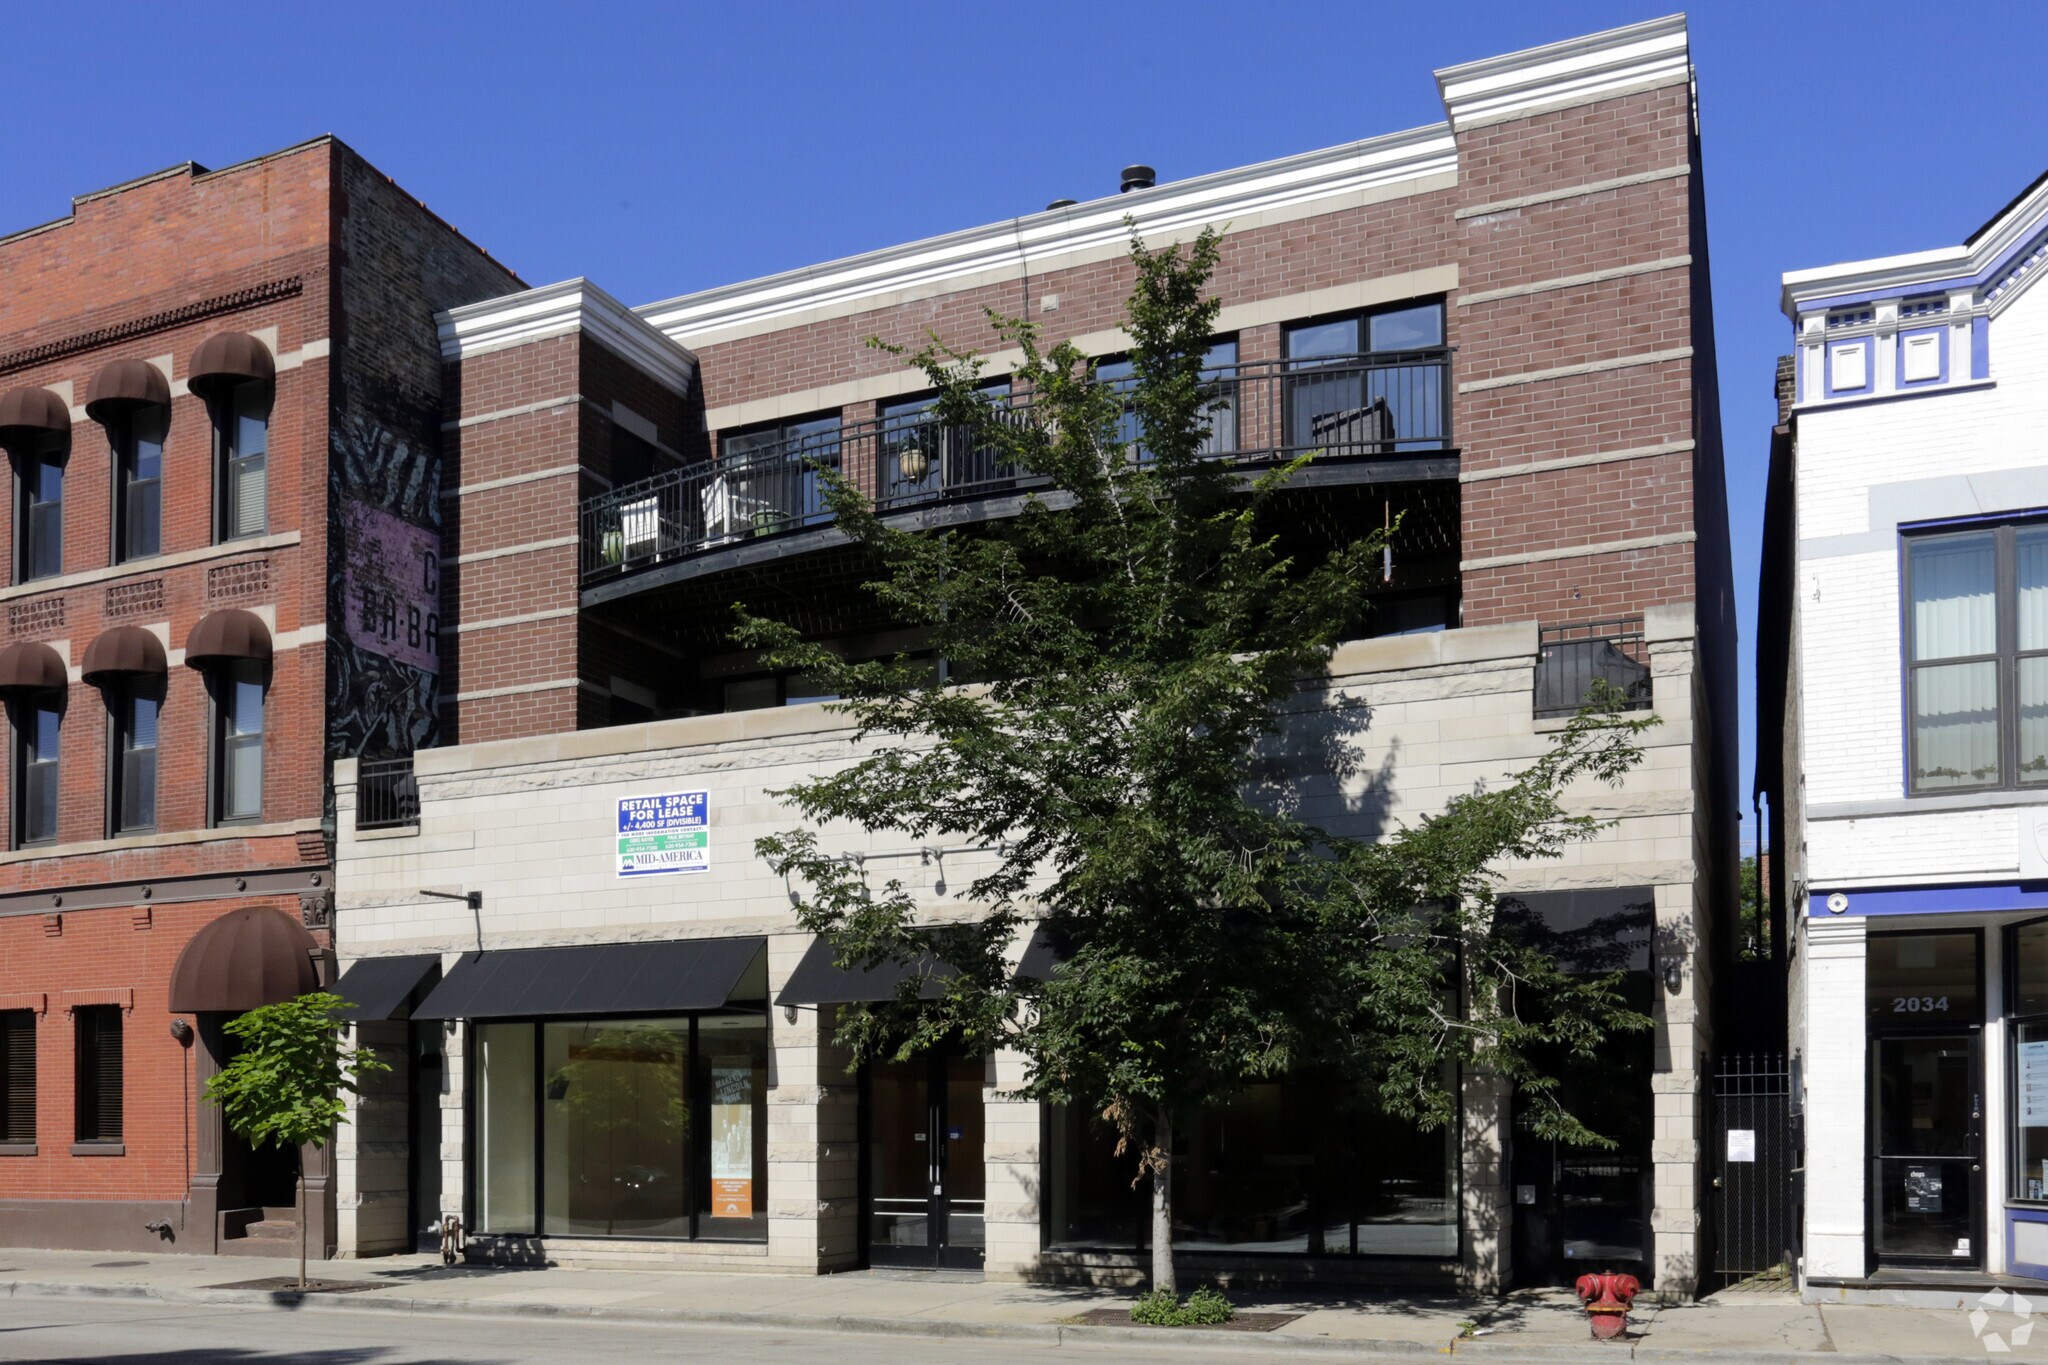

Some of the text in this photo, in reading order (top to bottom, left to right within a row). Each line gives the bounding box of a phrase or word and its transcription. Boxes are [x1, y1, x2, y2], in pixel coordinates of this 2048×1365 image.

[622, 794, 703, 811] RETAIL SPACE
[630, 806, 693, 821] FOR LEASE
[635, 820, 655, 830] 4,400
[666, 816, 701, 827] (DIVISIBLE)
[636, 850, 703, 865] MID-AMERICA
[1893, 996, 1949, 1012] 2034
